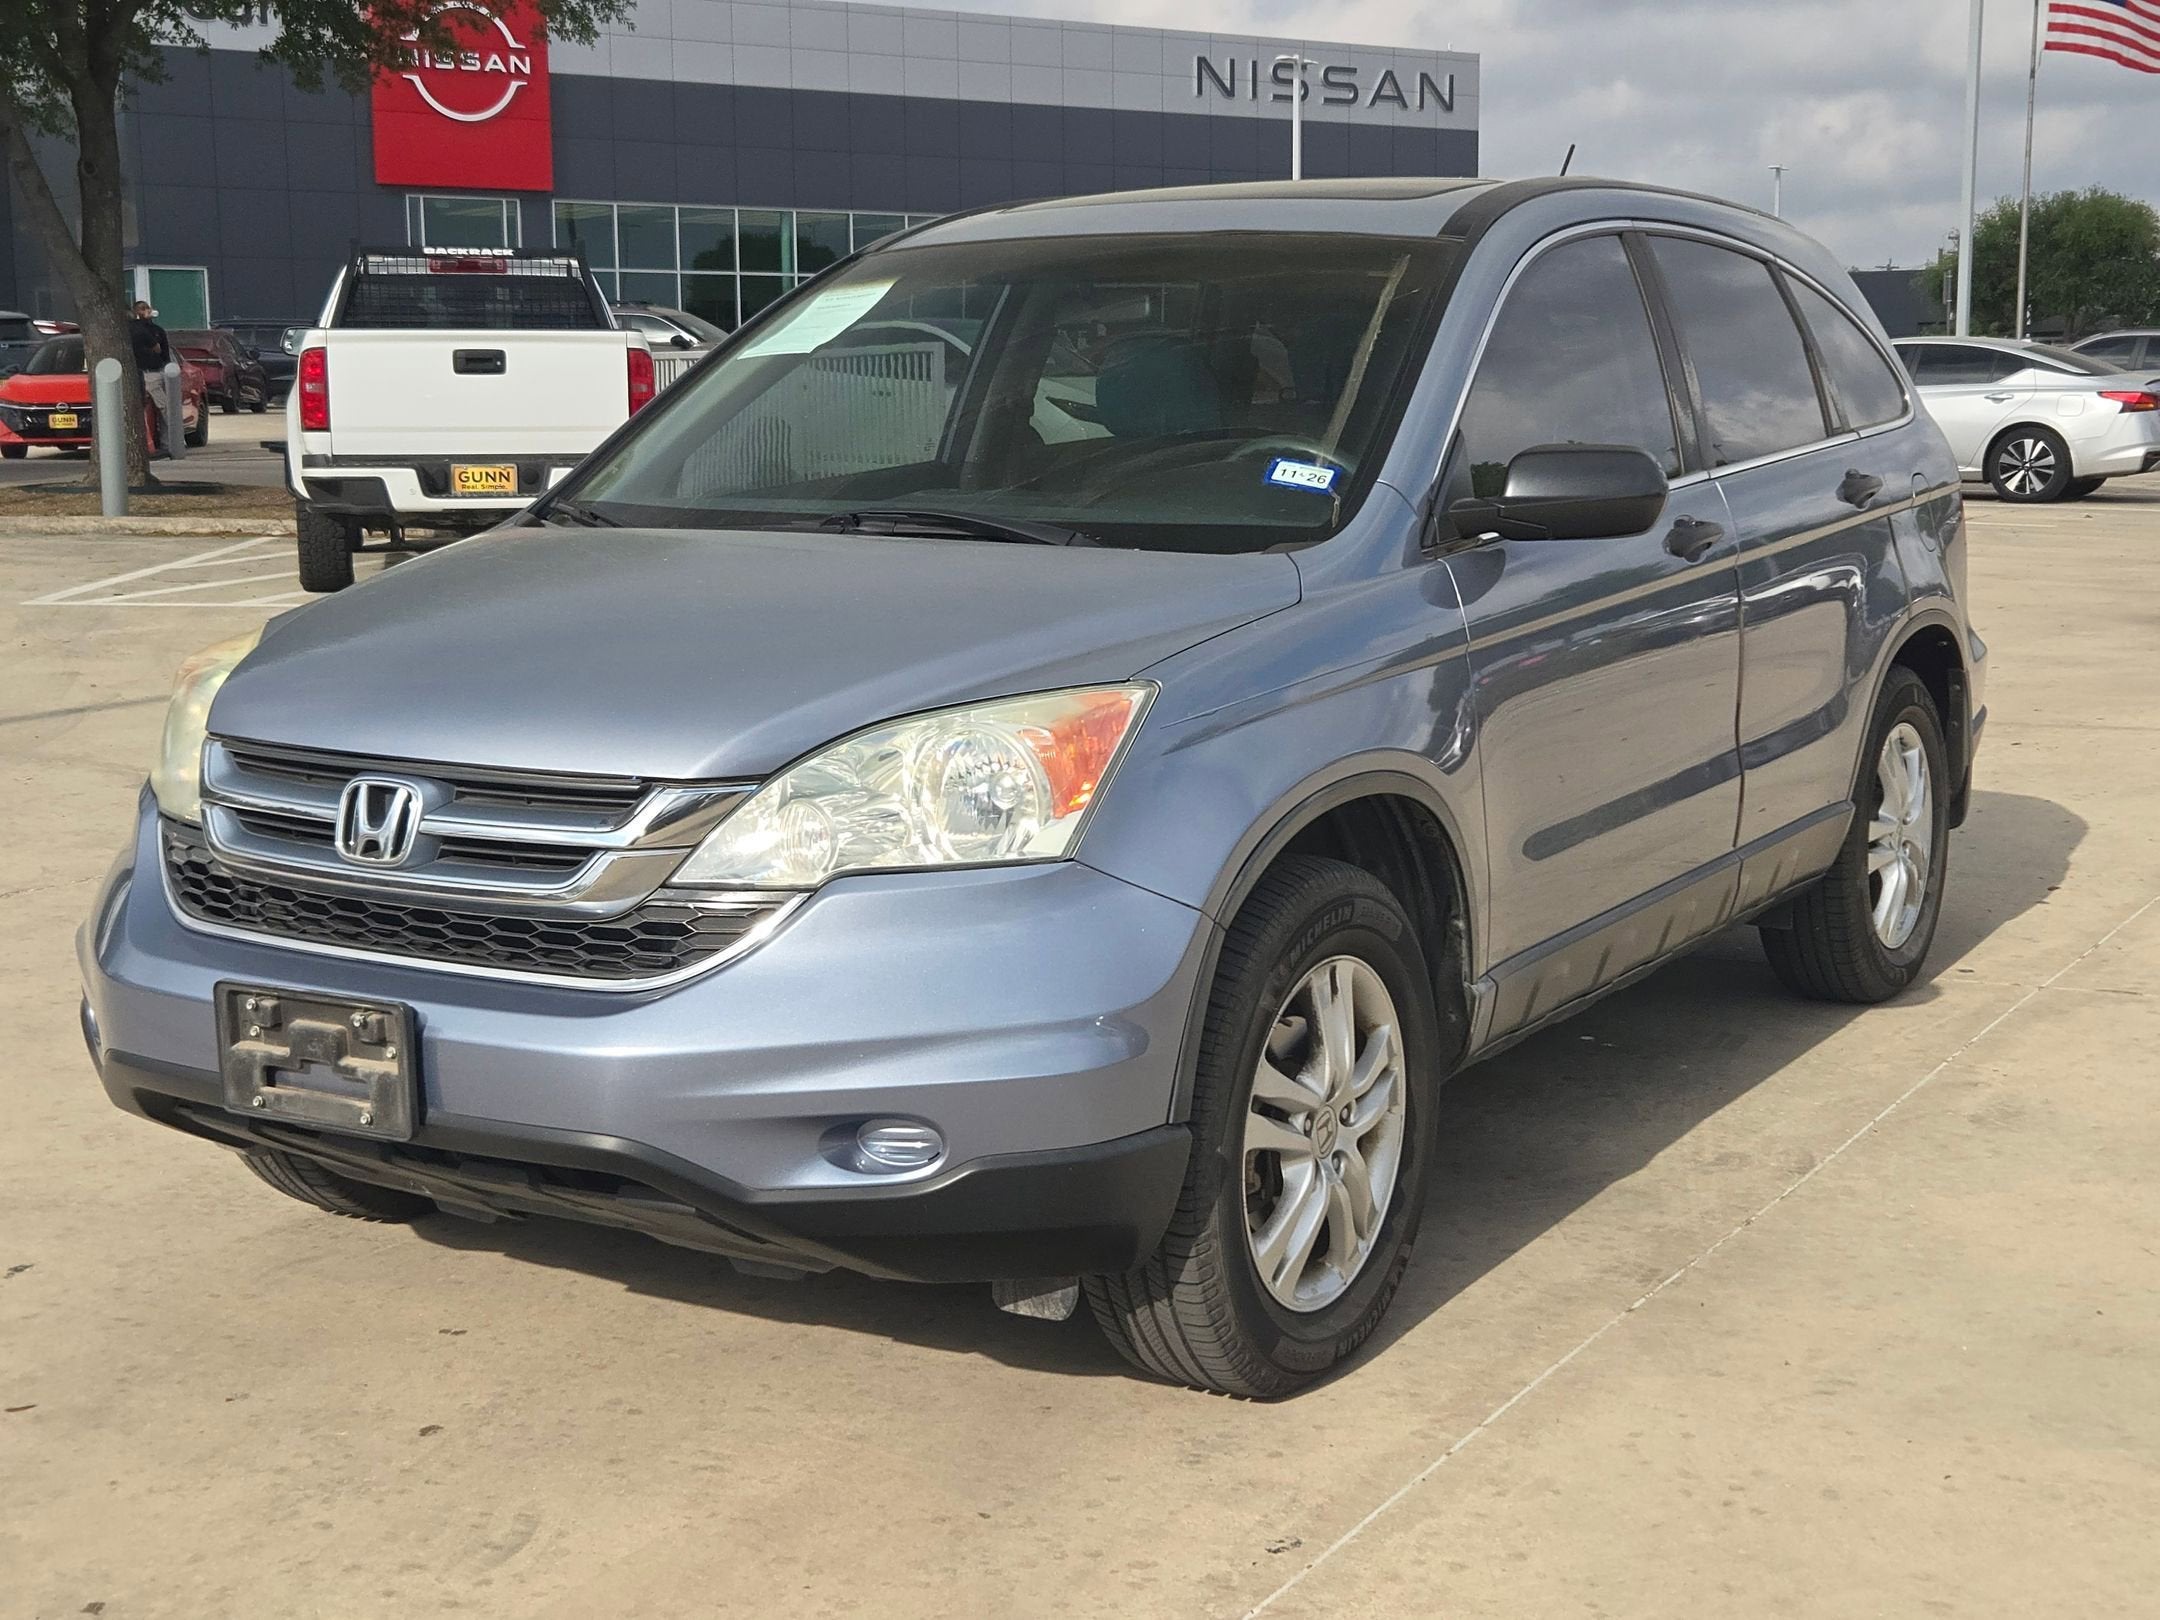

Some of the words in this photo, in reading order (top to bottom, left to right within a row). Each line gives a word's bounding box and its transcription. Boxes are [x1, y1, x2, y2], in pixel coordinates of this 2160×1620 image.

[1195, 56, 1454, 112] NISSAN
[423, 247, 514, 256] BACKRACK
[458, 471, 511, 483] GUNN
[1289, 903, 1353, 968] MICHELIN
